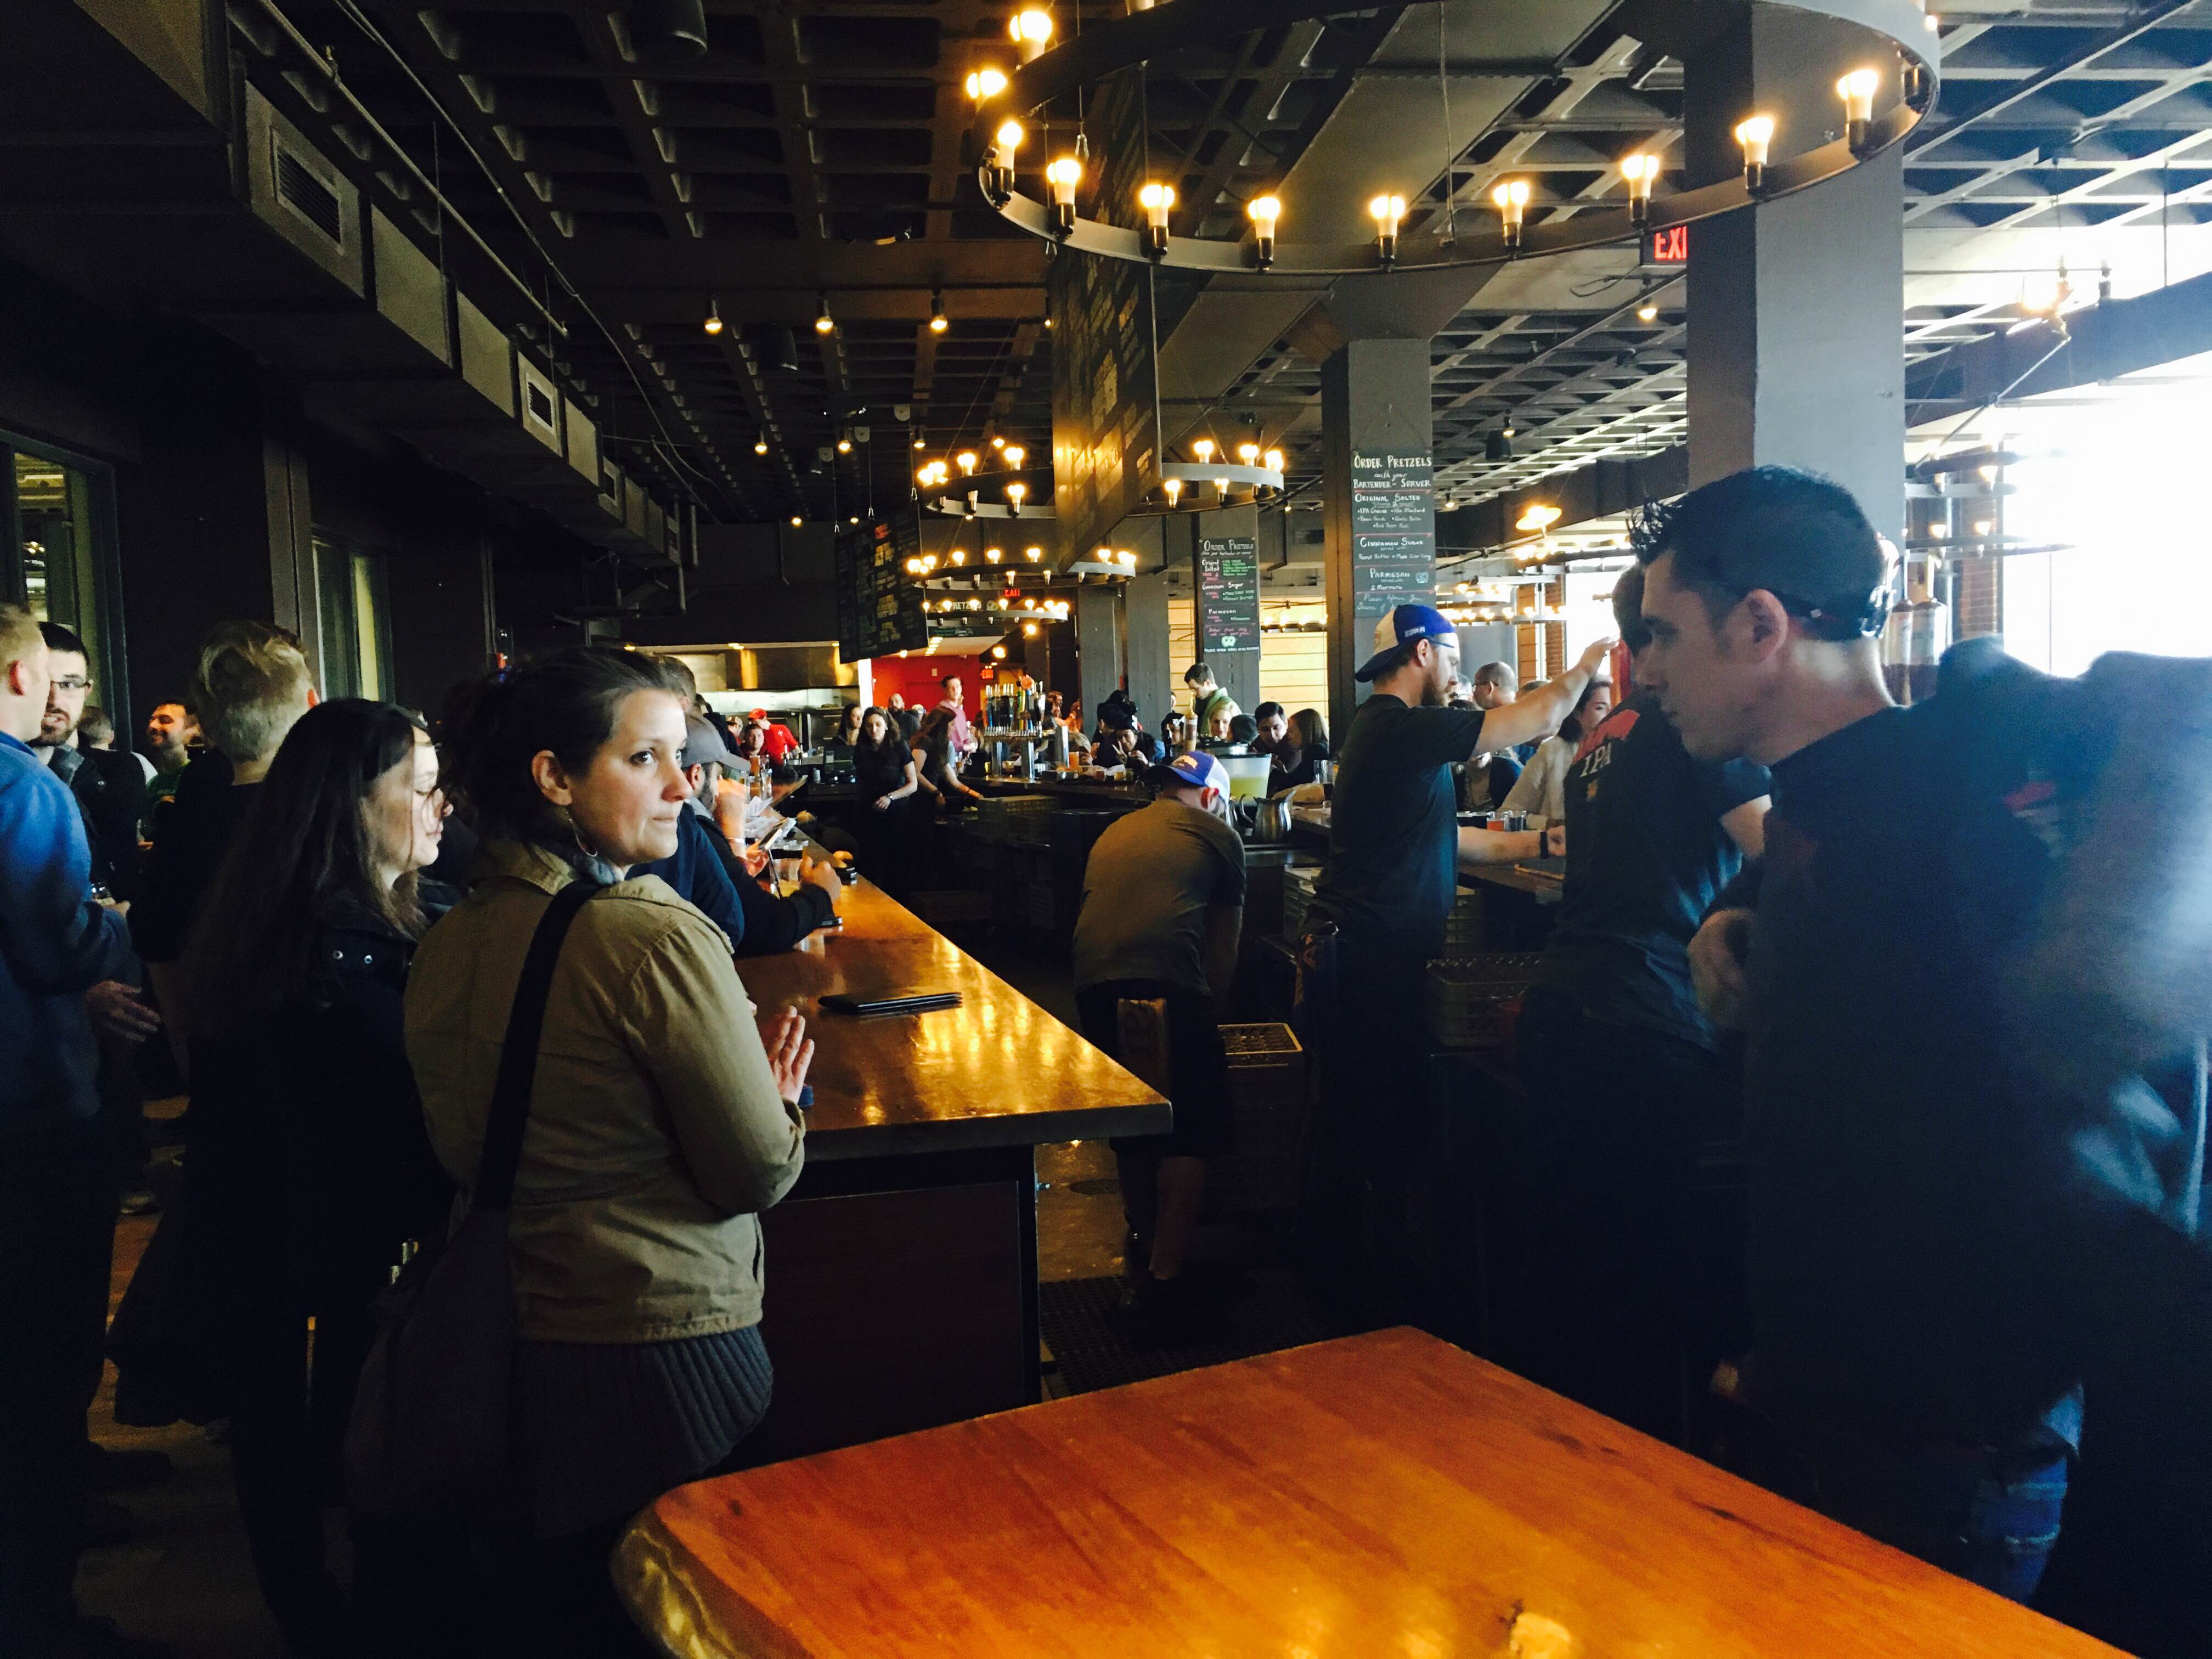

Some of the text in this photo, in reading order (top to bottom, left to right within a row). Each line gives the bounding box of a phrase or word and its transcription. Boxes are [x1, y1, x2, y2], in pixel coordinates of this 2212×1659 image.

[1654, 225, 1687, 259] EXI
[1354, 455, 1432, 469] ORDER PRETZELS
[1374, 470, 1407, 482] with your
[1353, 479, 1391, 488] BARTENDER
[1401, 478, 1431, 487] SERVER
[1355, 493, 1420, 502] ORIGINAL SALTED
[1360, 537, 1424, 548] CINNAMON SUGAR
[1369, 568, 1410, 578] PARMESAN
[949, 601, 982, 610] RETZS
